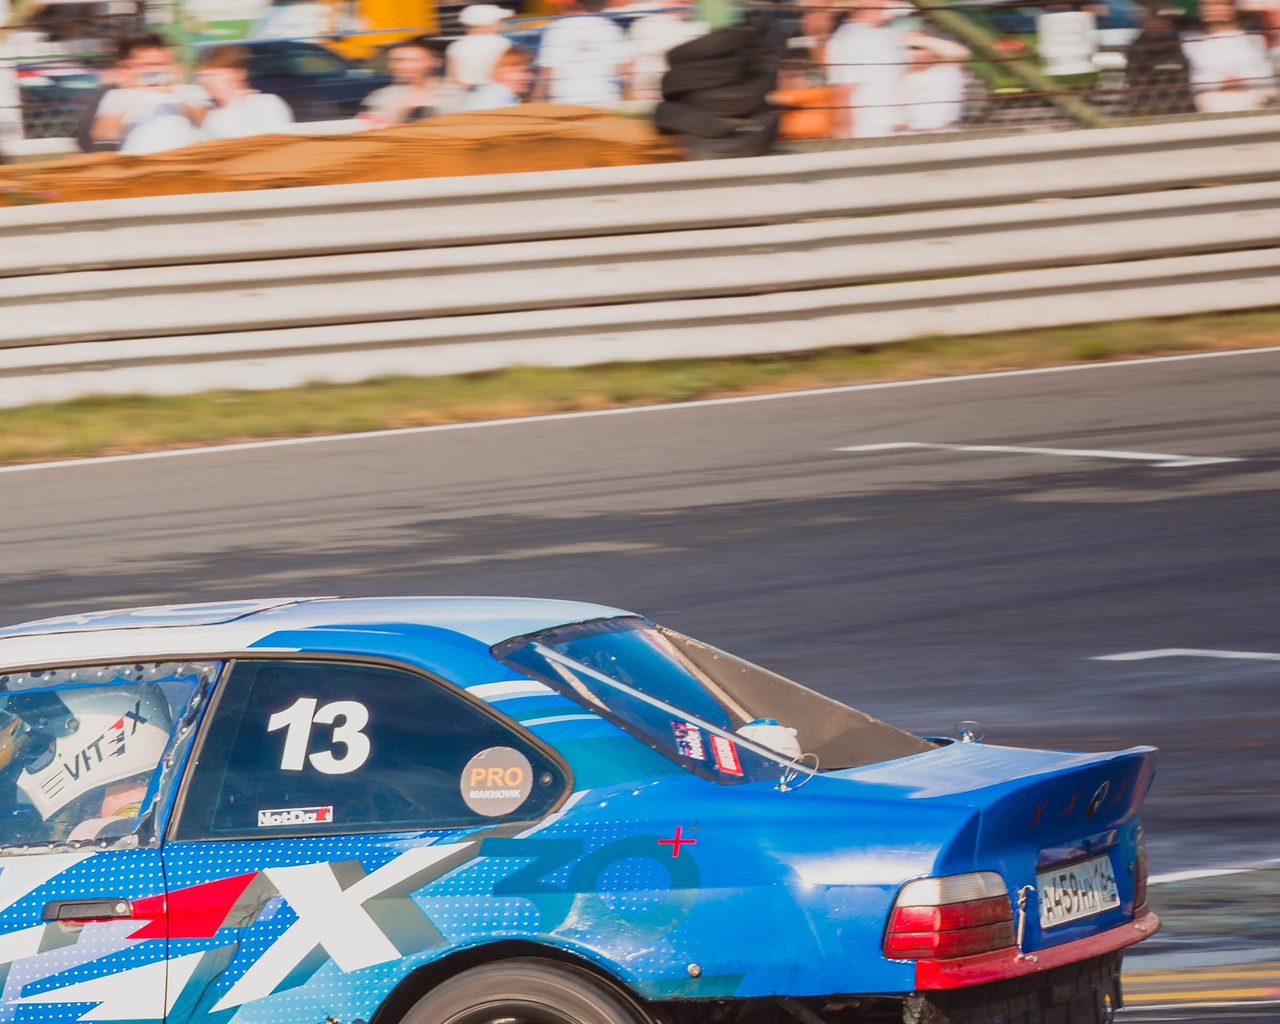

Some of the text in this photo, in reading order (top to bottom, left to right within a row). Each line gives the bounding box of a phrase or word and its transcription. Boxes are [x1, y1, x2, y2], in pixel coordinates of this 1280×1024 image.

[63, 700, 148, 781] VITEX
[267, 697, 371, 775] 13
[469, 789, 522, 799] MAKHOVIK
[470, 766, 524, 788] PRO
